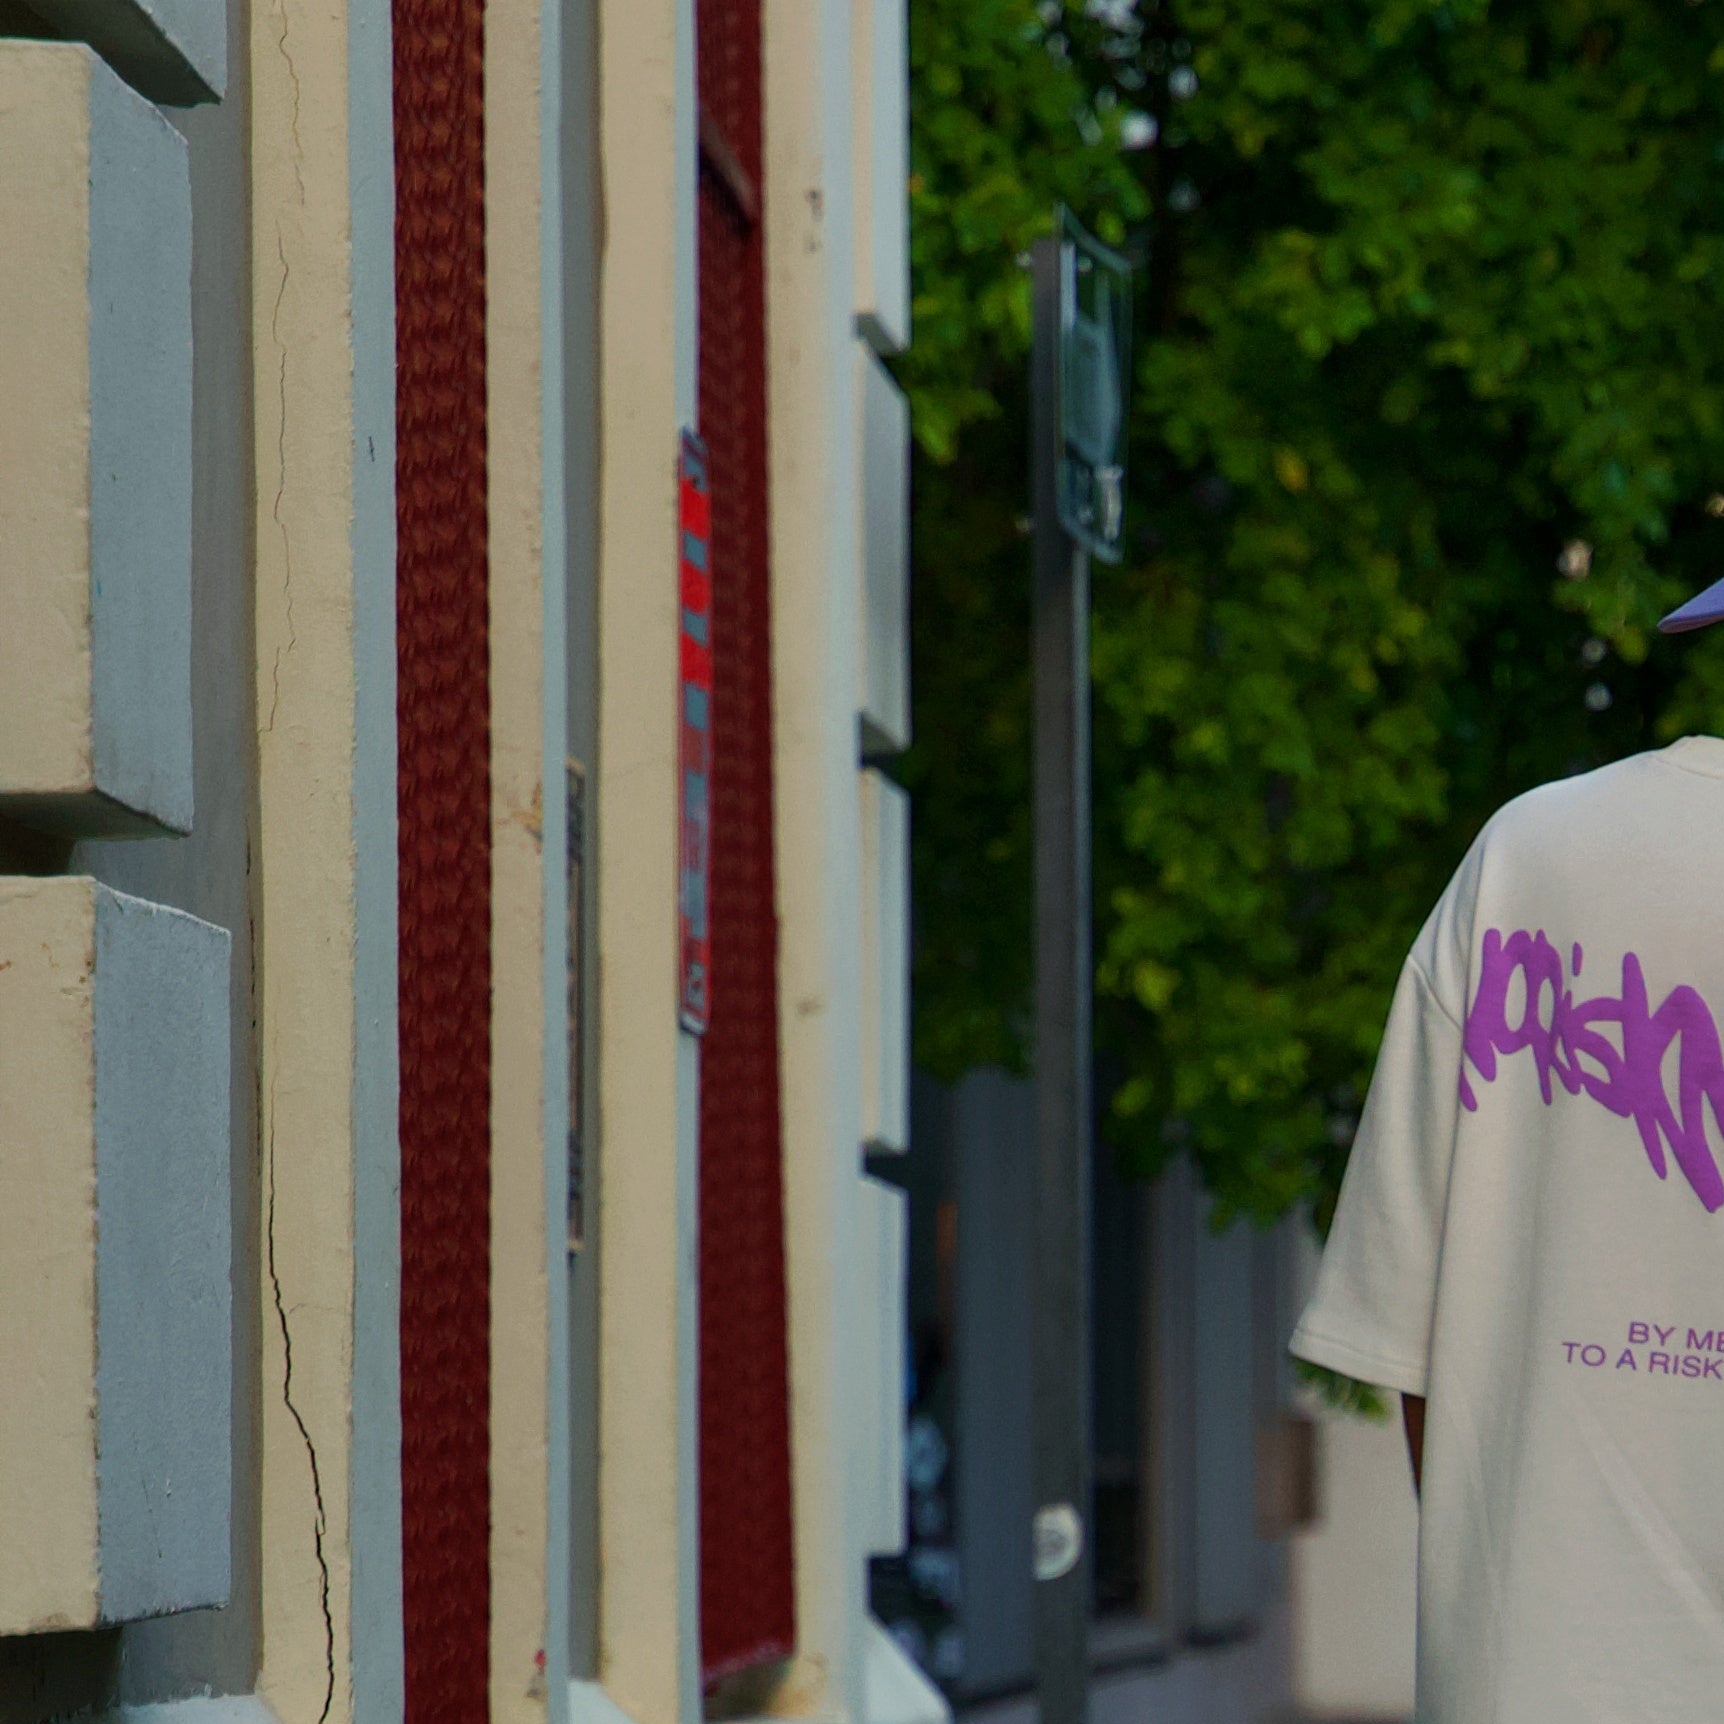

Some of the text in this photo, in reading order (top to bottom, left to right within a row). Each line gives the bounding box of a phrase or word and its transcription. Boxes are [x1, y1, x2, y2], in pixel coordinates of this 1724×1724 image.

[1627, 1321, 1677, 1346] BY
[1561, 1341, 1607, 1367] TO
[1615, 1347, 1637, 1371] A
[1648, 1351, 1724, 1380] RISK
